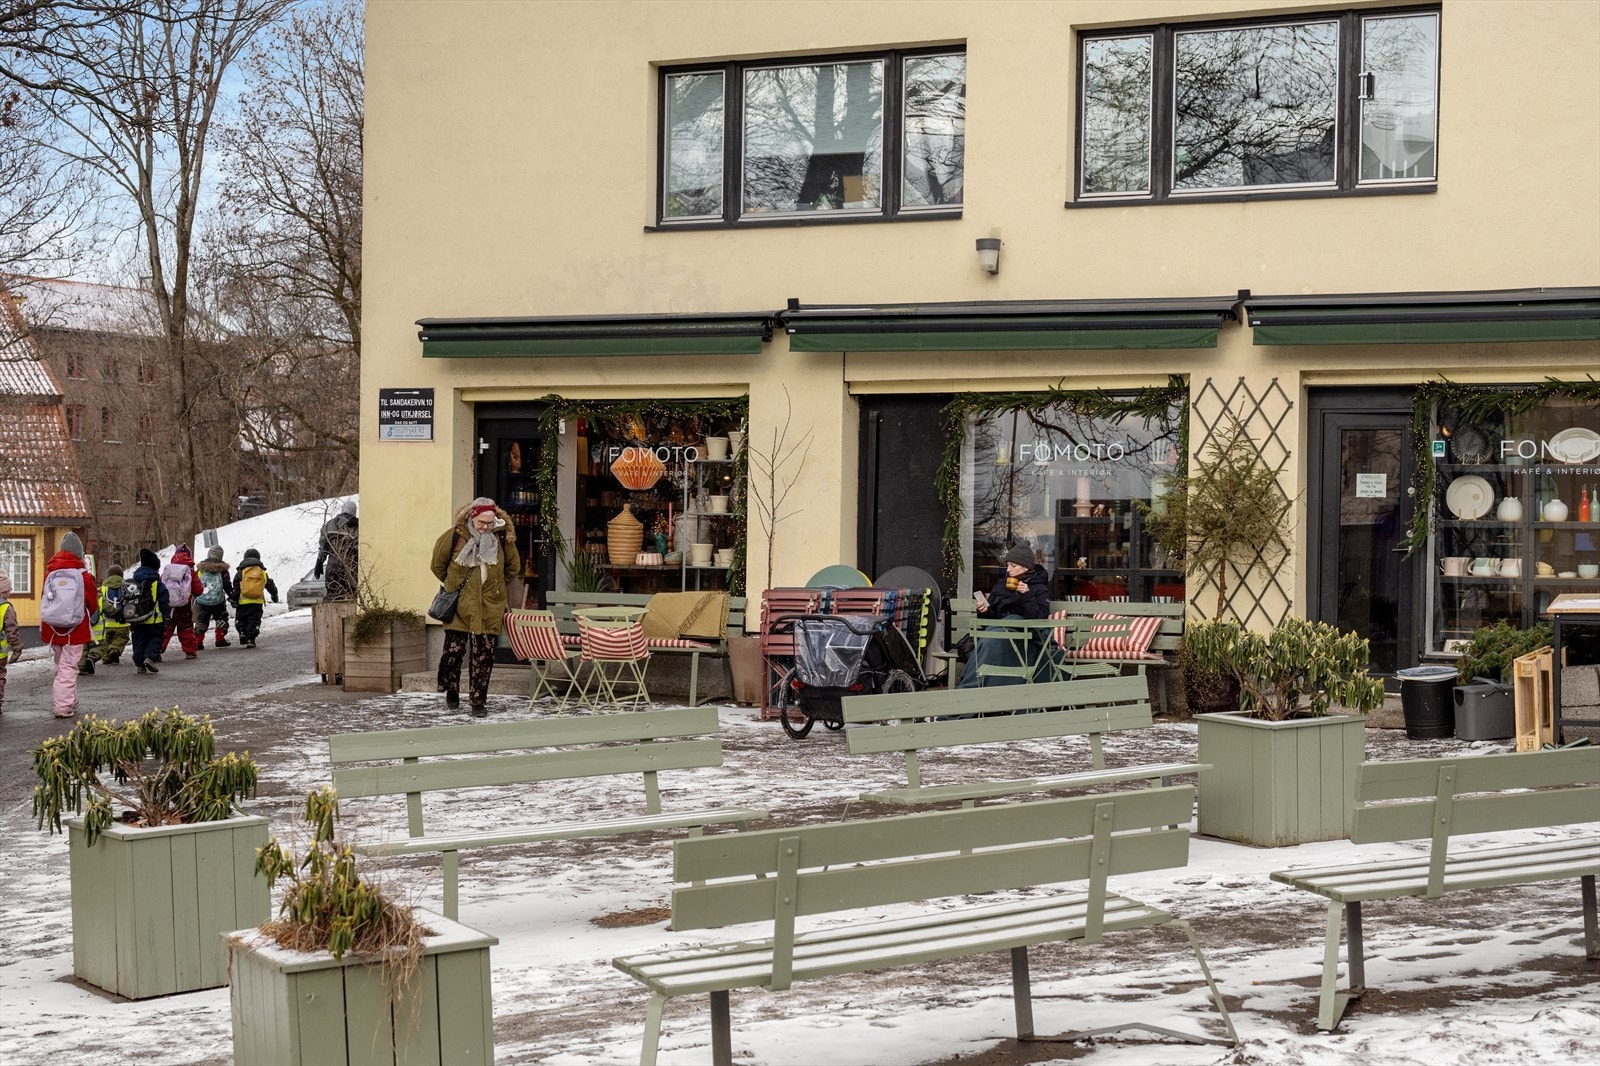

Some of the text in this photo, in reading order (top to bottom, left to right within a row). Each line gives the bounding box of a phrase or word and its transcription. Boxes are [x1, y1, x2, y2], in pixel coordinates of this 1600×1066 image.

[380, 398, 388, 406] TIL
[400, 410, 432, 418] UTKJØRSEL
[608, 446, 699, 463] FOMOTO
[1020, 443, 1124, 461] FOMOTO
[1514, 467, 1541, 475] KAFÉ
